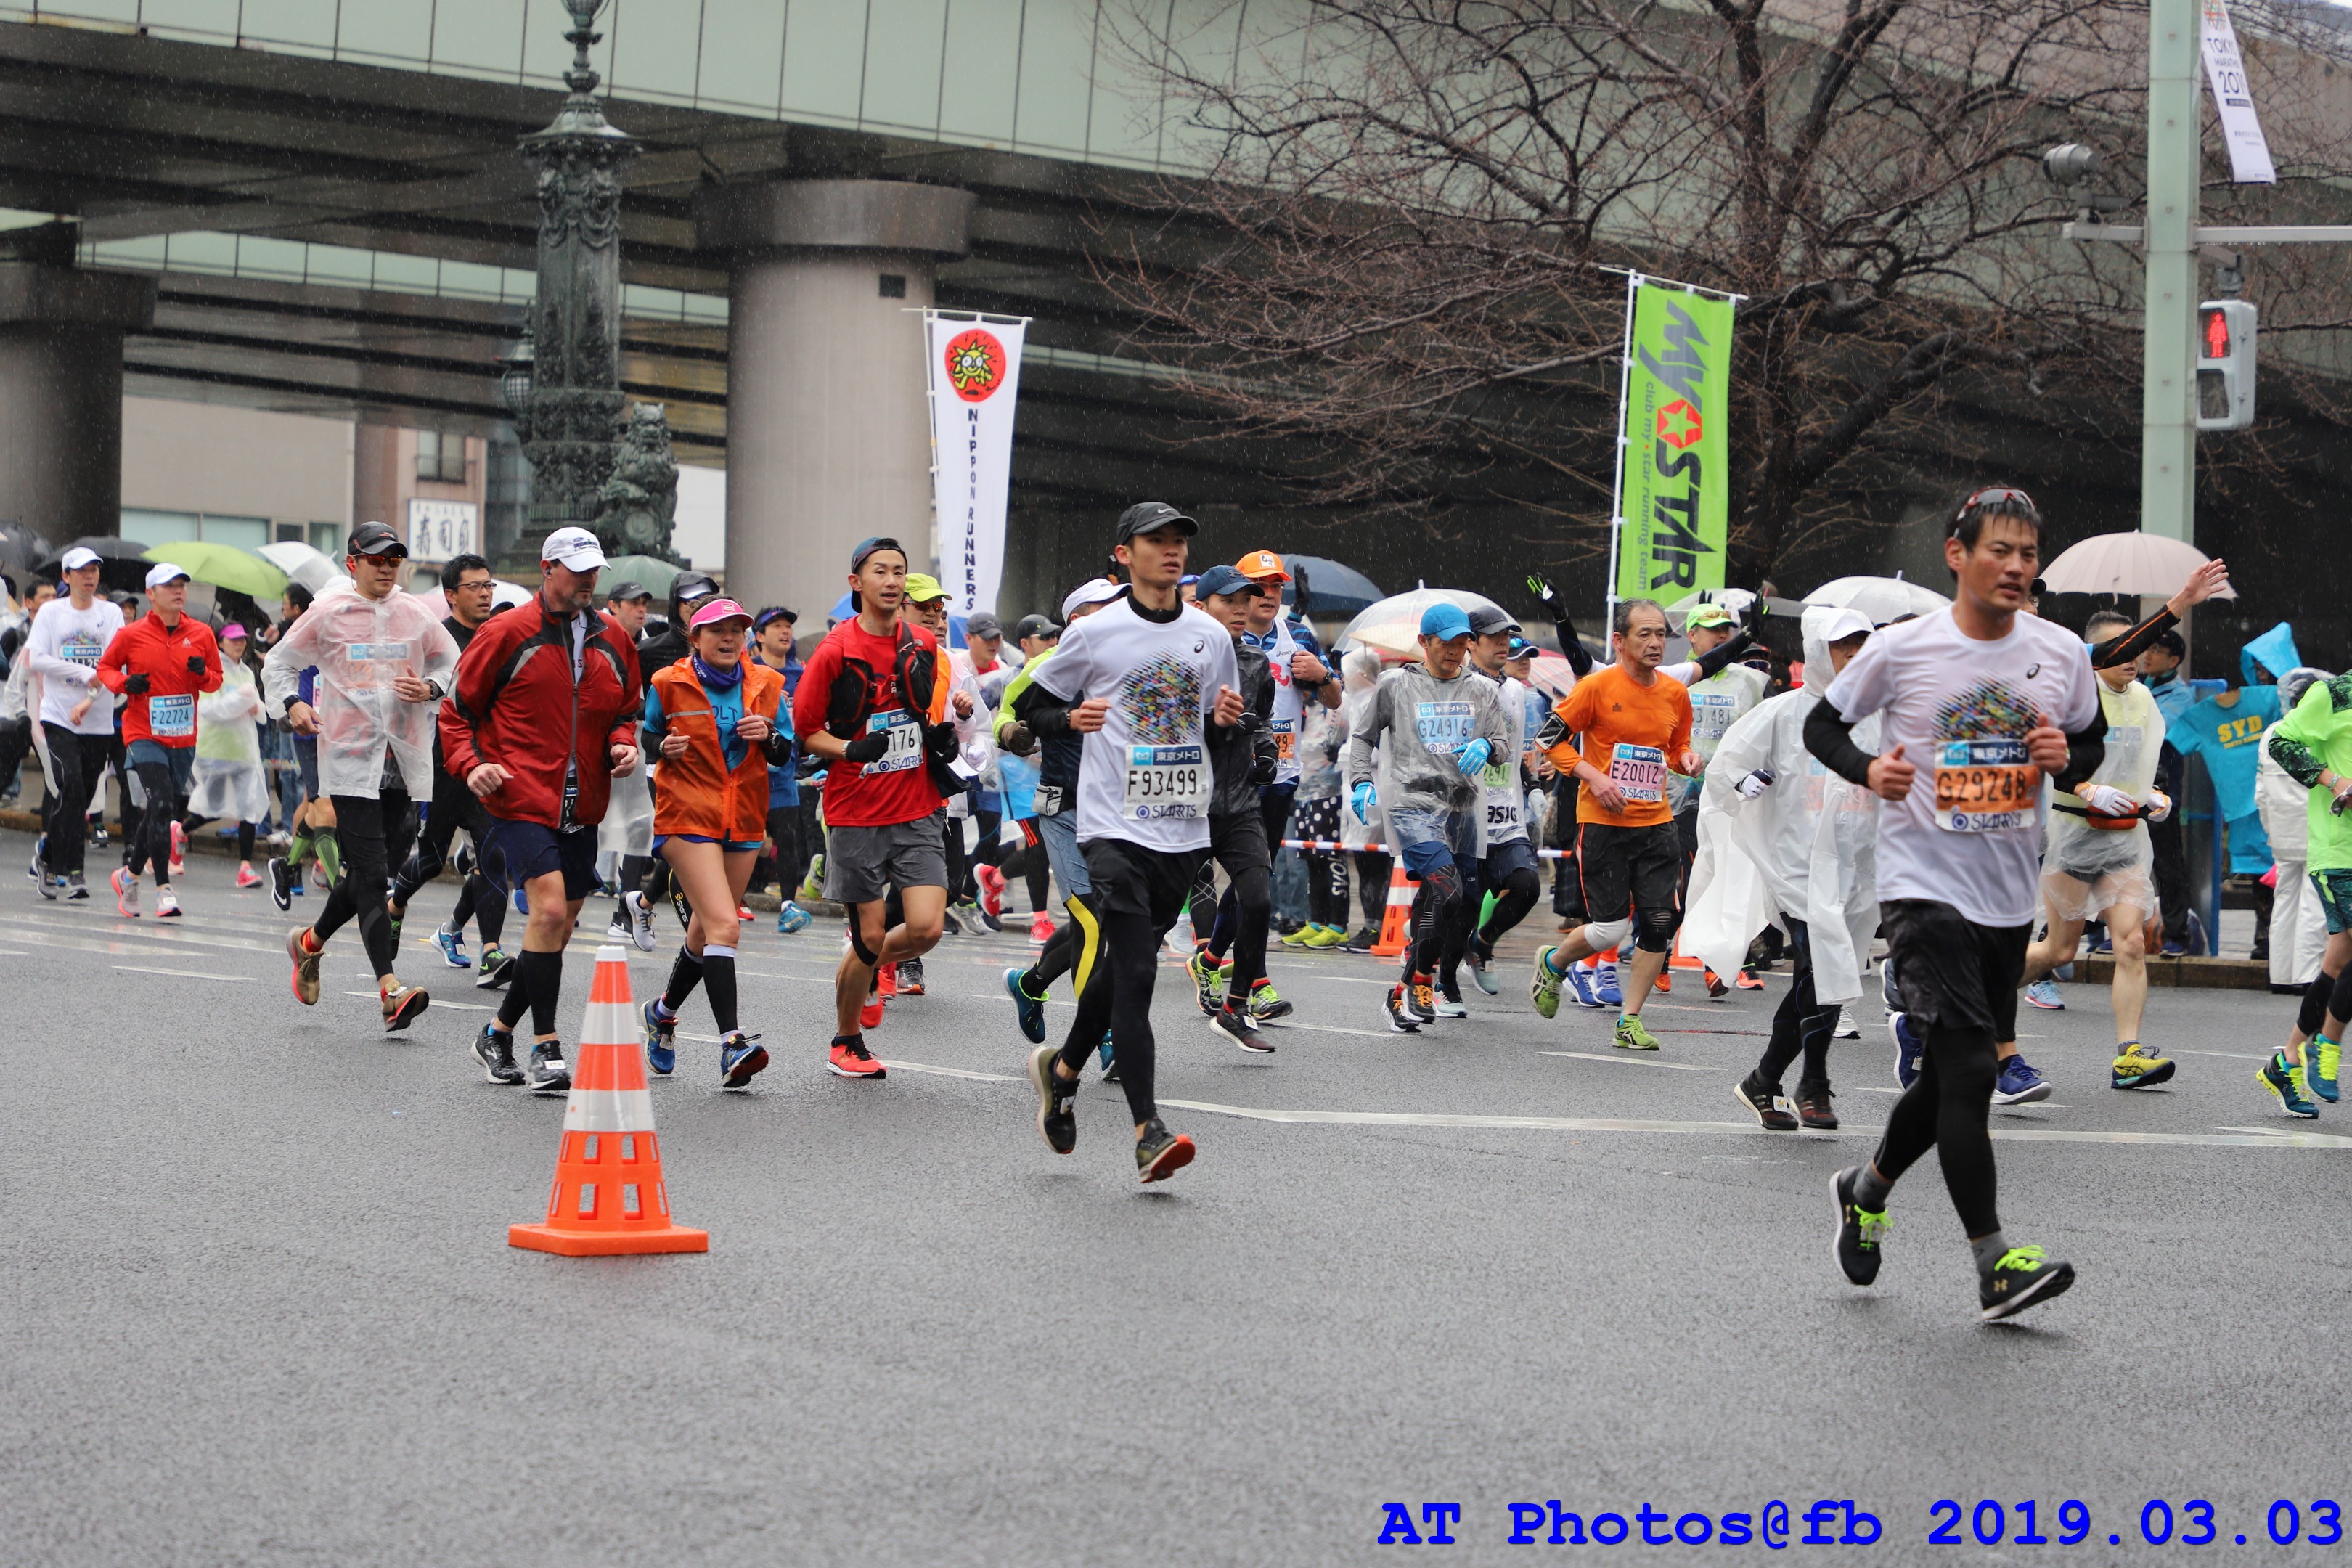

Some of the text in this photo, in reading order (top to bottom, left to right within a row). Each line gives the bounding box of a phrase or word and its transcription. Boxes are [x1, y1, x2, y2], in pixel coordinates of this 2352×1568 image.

[1638, 382, 1656, 591] club my star running team
[965, 409, 978, 610] NIPPON RUNNERS
[1651, 436, 1717, 591] STAR
[152, 709, 189, 724] F22724
[711, 705, 738, 730] OLT
[1692, 707, 1730, 724] 31481
[1418, 719, 1467, 738] G24916
[2218, 715, 2262, 743] SYD
[1156, 750, 1200, 761] 東京メトロ
[1128, 769, 1196, 796] F93499
[1612, 760, 1659, 784] E20012
